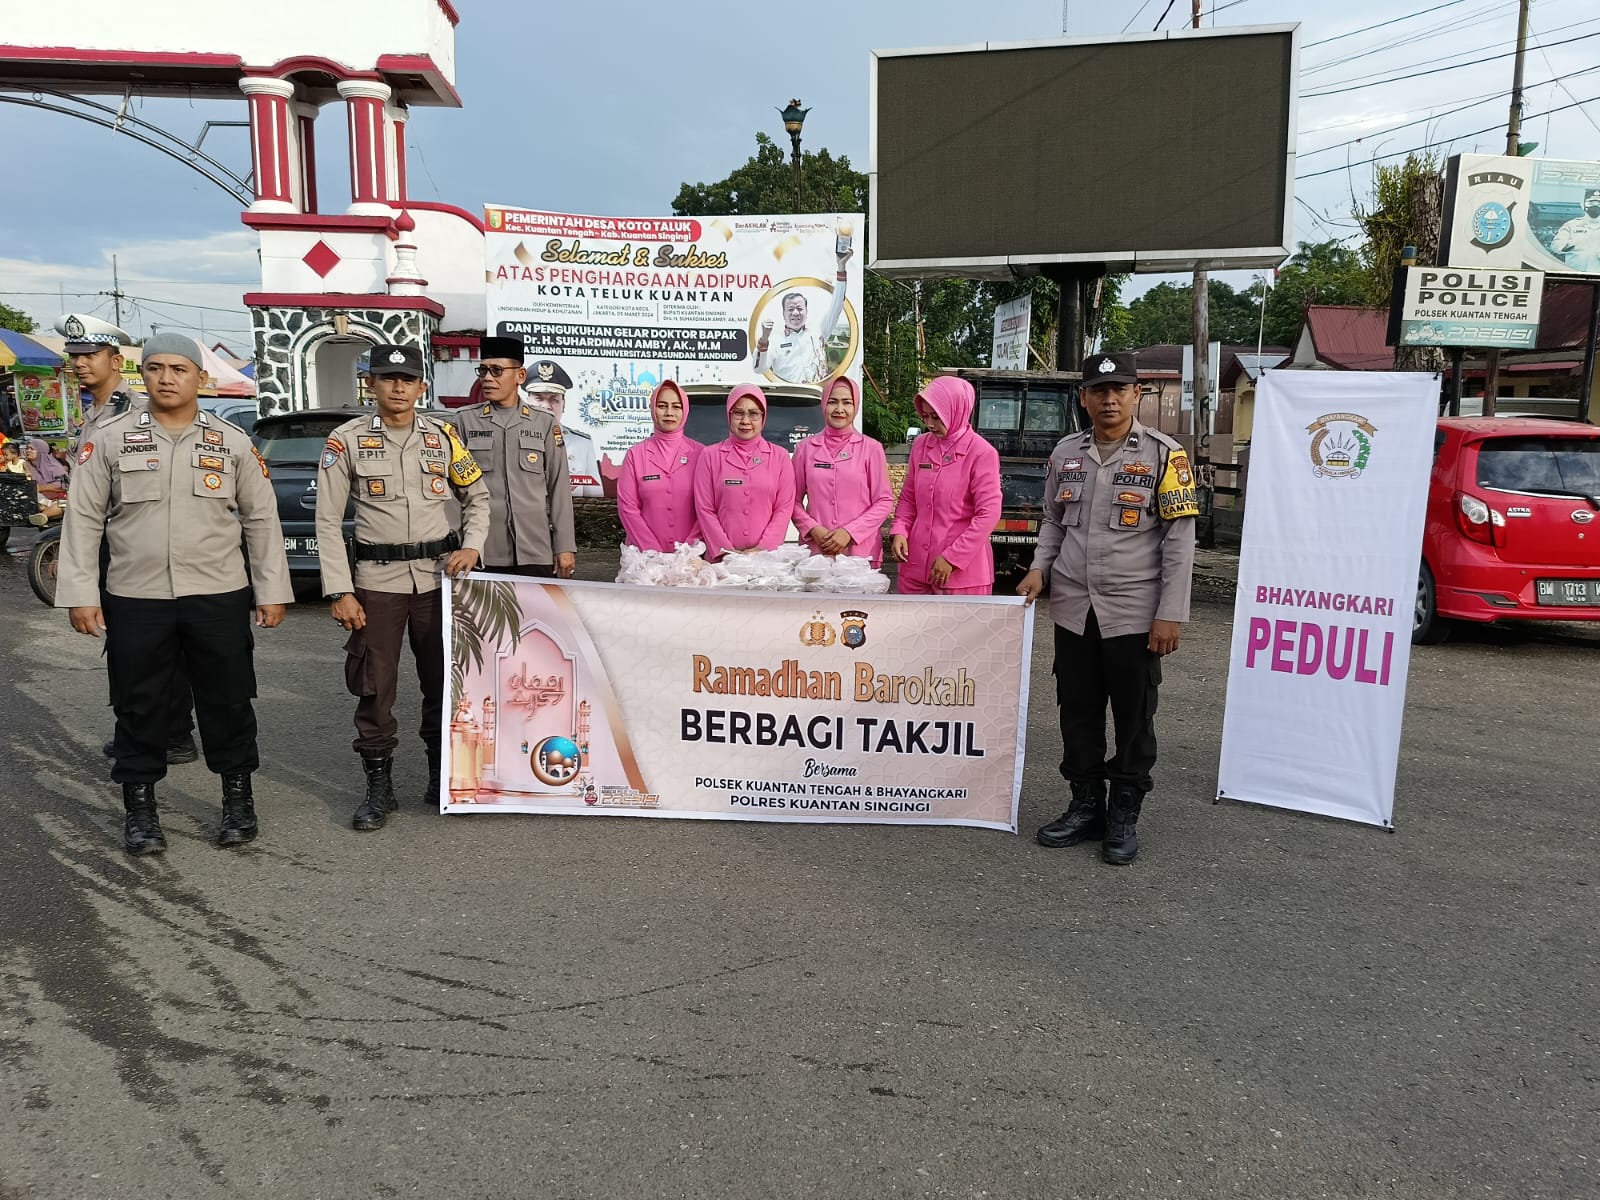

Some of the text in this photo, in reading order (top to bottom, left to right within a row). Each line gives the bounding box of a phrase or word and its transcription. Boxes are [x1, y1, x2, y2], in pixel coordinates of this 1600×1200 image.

[1474, 174, 1518, 186] RIAU
[505, 212, 691, 232] PEMERINTAH DESA KOTO TALUK
[505, 223, 524, 232] Kec.
[525, 225, 562, 236] Kuantan
[564, 228, 594, 239] Tengah
[600, 231, 620, 240] Kab.
[621, 232, 657, 241] Kuantan
[658, 232, 691, 243] Singingi
[541, 238, 728, 269] Selamat & Sukses
[496, 265, 772, 288] ATAS PENGHARGAAN ADIPURA
[1420, 272, 1532, 291] POLISI
[538, 284, 733, 302] KOTA TELUK KUANTAN
[1418, 292, 1528, 308] POLICE
[1414, 308, 1528, 321] POLSEK KUANTAN TENGAH
[506, 322, 737, 340] DAN PENGUKUHAN GELAR DOKTOR BAPAK
[524, 334, 541, 345] Dr.
[542, 335, 554, 346] H.
[556, 336, 633, 348] SUHARDIMAN
[636, 339, 672, 352] AMBY,
[698, 341, 720, 351] M.M
[530, 346, 562, 356] SIDANG
[562, 348, 600, 356] TERBUKA
[600, 349, 651, 358] UNIVERSITAS
[652, 350, 696, 360] PASUNDAN
[698, 352, 738, 360] BANDUNG
[520, 430, 543, 440] POLISI
[120, 444, 158, 454] JONDERI
[194, 443, 231, 455] POLRI
[358, 450, 386, 459] EPIT
[420, 449, 446, 458] POLRI
[1116, 474, 1152, 487] POLRI
[284, 538, 297, 550] BM
[1255, 584, 1395, 618] BHAYANGKARI
[1246, 616, 1395, 687] PEDULI
[692, 654, 976, 707] Ramadhan Barokah
[681, 708, 985, 757] BERBAGI TAKJIL
[802, 758, 858, 778] Bersama
[695, 777, 968, 799] POLSEK KUANTAN TENGAH & BHAYANGKARI
[730, 796, 930, 812] POLRES KUANTAN SINGINGI
